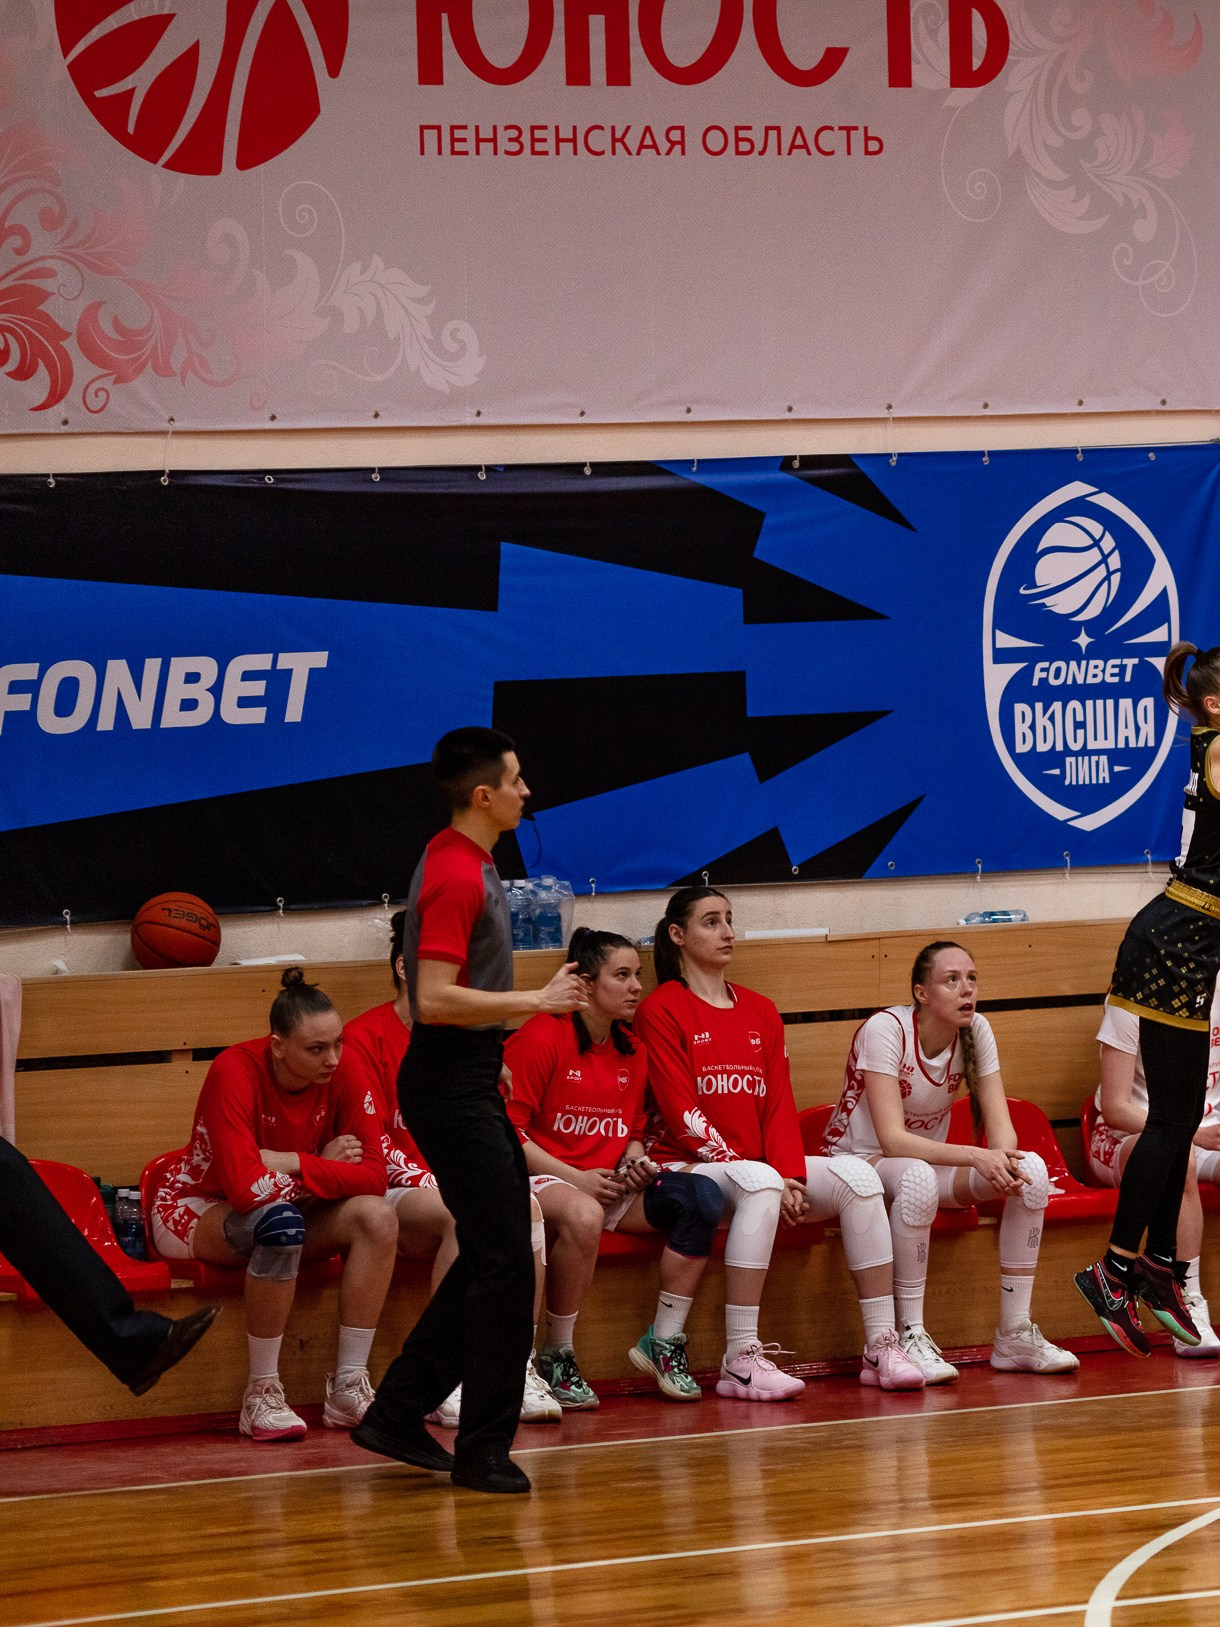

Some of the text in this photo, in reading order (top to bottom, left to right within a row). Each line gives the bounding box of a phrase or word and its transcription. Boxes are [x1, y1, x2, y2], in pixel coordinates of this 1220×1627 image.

[418, 123, 885, 157] ПЕНЗЕНСКАЯ ОБЛАСТЬ
[1032, 658, 1140, 687] FONBET
[0, 651, 329, 735] FONBET
[1013, 697, 1156, 754] ВЫСШАЯ
[1064, 755, 1110, 786] ЛИГА
[697, 1073, 767, 1098] ЮНОСТЬ
